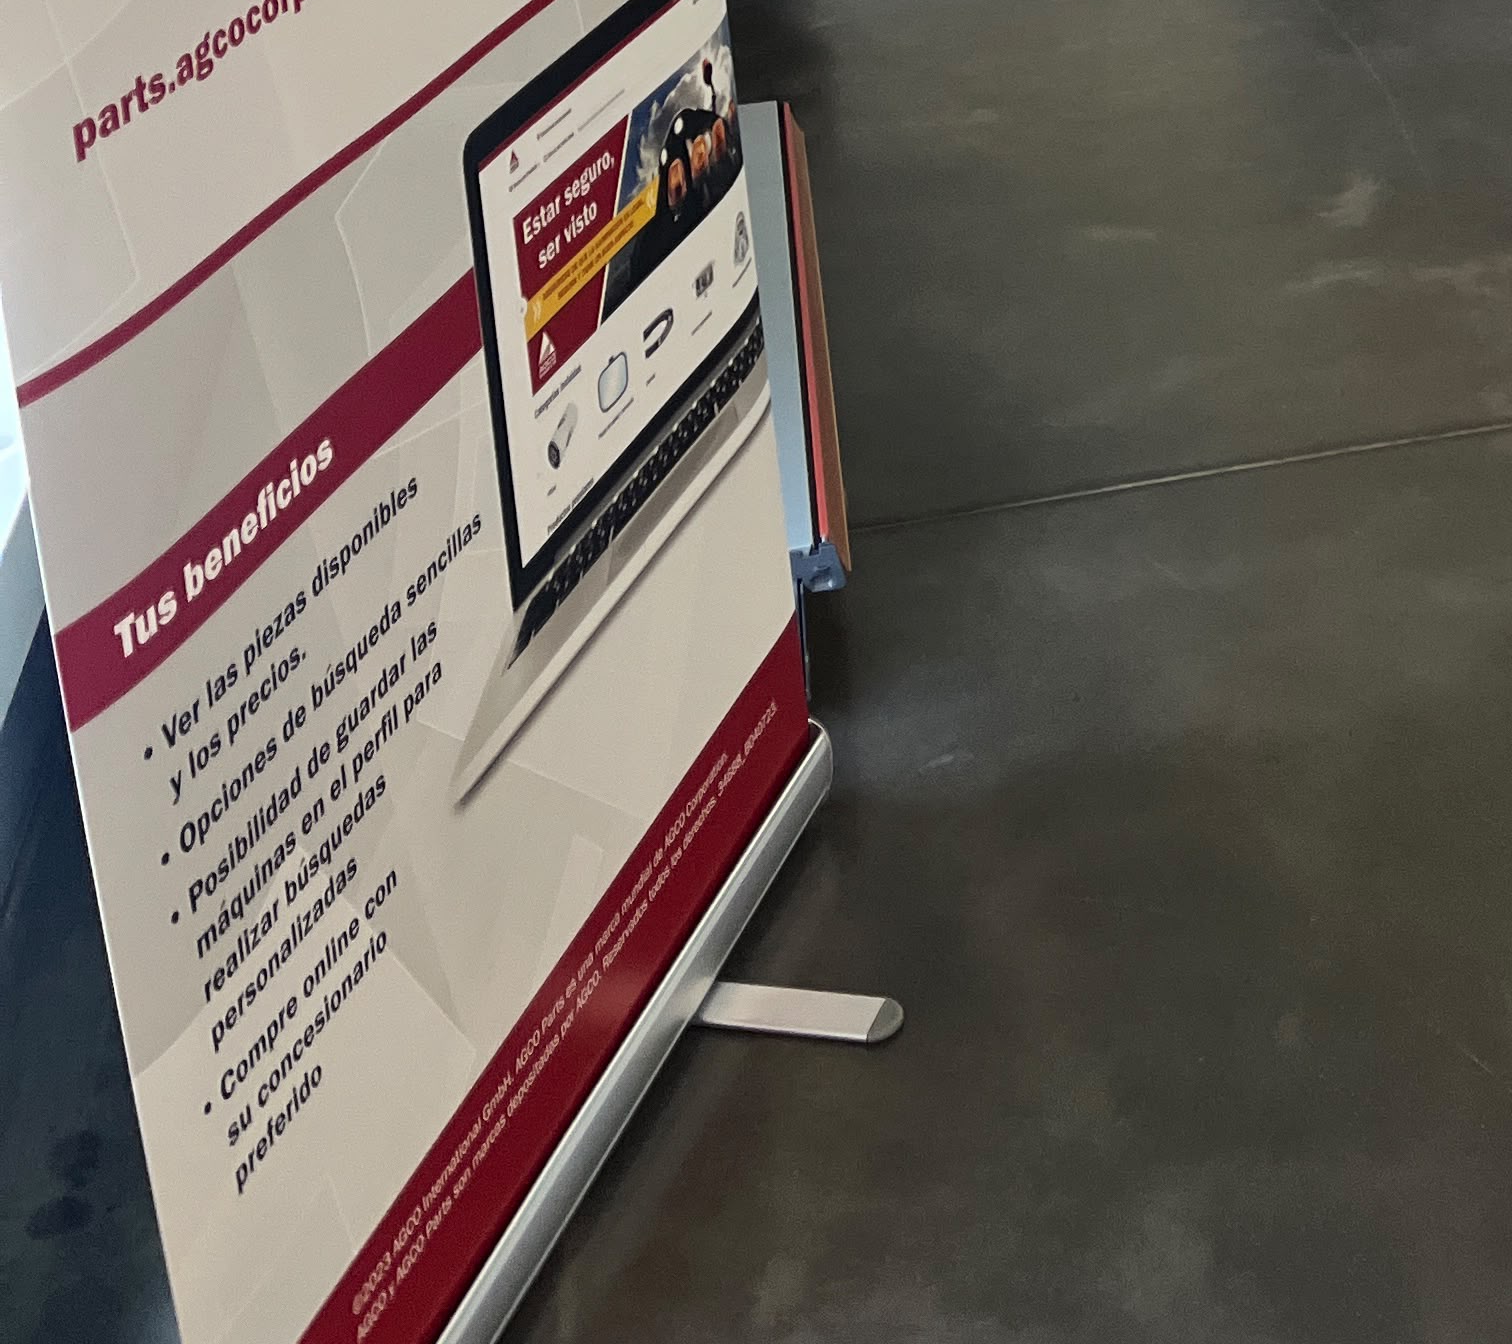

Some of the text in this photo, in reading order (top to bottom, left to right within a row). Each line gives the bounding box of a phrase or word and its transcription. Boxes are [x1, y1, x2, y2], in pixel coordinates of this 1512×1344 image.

[522, 194, 561, 245] Estar
[564, 149, 615, 205] seguro,
[537, 201, 598, 269] ser visto
[113, 437, 334, 658] Tus beneficios
[161, 474, 420, 750] Ver las piezas disponibles
[168, 646, 307, 807] y los precios.
[179, 512, 482, 854] Opciones de búsqueda sencillas
[187, 621, 439, 916] Posibilidad de guardar las
[197, 661, 444, 959] máquinas en el perfil para
[203, 772, 387, 1003] realizar búsquedas
[210, 856, 359, 1054] personalizadas
[219, 869, 399, 1101] Compre online con
[227, 929, 388, 1147] su concesionario
[357, 1292, 387, 1344] AGCO
[396, 1234, 425, 1285] AGCO
[426, 1197, 452, 1239] Parts
[453, 1167, 471, 1199] son
[472, 1114, 506, 1171] marcas
[507, 1034, 560, 1117] depositadas
[560, 1011, 575, 1041] por
[602, 899, 648, 971] Reservados
[648, 866, 671, 902] todos
[671, 847, 682, 868] los
[683, 796, 717, 849] derechos
[393, 1206, 422, 1257] AGCO
[422, 1118, 482, 1210] International
[483, 1070, 514, 1120] GmbH.
[515, 1030, 540, 1073] AGCO
[541, 996, 564, 1033] Parts
[565, 978, 578, 999] es
[577, 953, 594, 982] una
[594, 912, 621, 955] marca
[621, 861, 653, 915] mundial
[653, 848, 663, 868] de
[664, 813, 686, 852] AGCO
[234, 1064, 324, 1195] preferido
